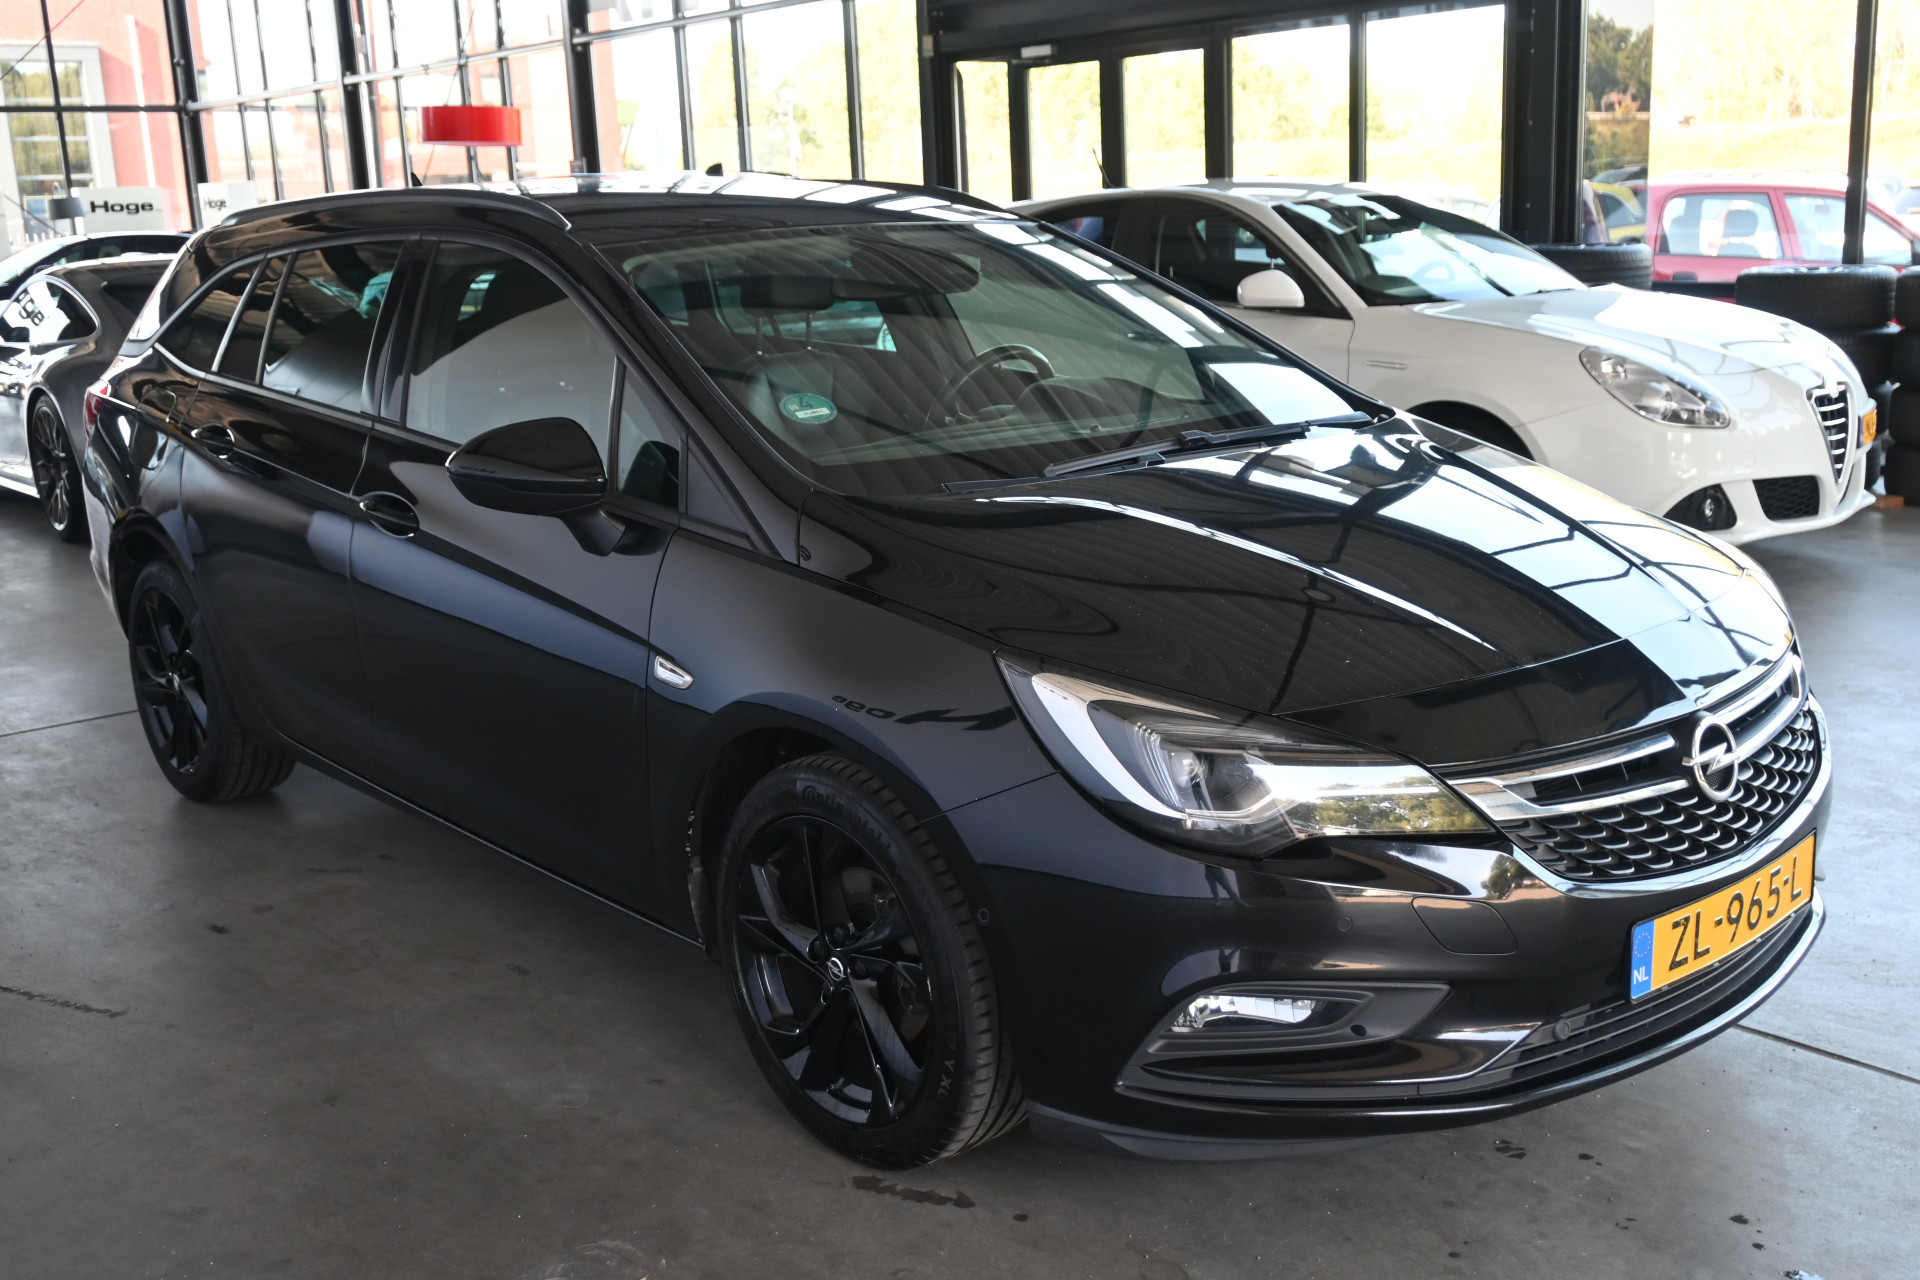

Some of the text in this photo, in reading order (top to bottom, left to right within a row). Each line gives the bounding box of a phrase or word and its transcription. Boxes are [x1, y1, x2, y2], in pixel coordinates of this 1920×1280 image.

[90, 200, 154, 215] Hoge
[1668, 854, 1802, 972] ZL-965-L
[1633, 965, 1649, 985] NL
